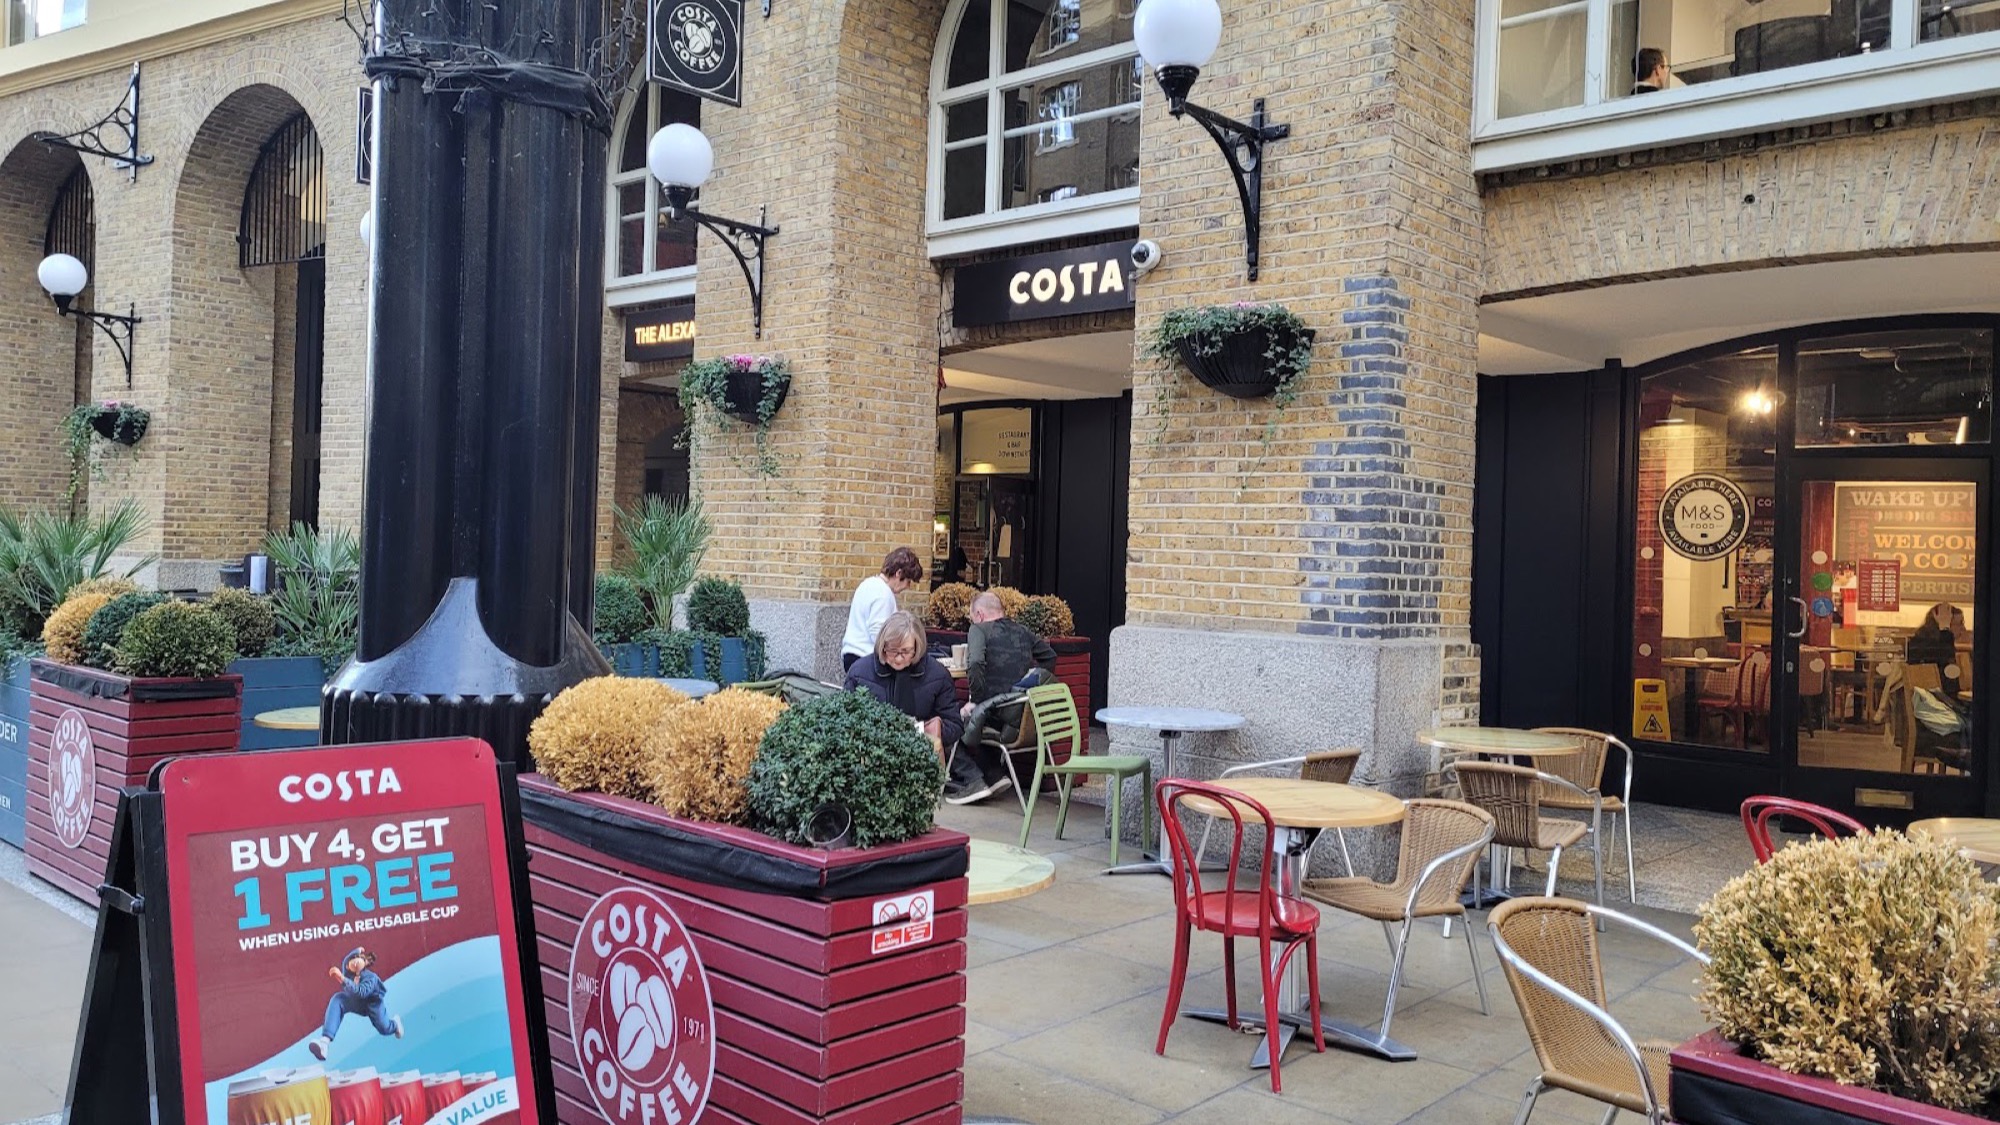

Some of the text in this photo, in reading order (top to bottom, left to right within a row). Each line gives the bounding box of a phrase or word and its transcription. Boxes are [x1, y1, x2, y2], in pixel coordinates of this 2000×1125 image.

[677, 6, 717, 32] COSTA
[674, 40, 721, 70] COFFEE
[1009, 258, 1125, 304] COSTA
[634, 325, 657, 345] THE
[1667, 480, 1740, 508] AVAILABLE HERE
[1851, 490, 1926, 506] WAKE
[1681, 504, 1726, 521] M&S
[1667, 530, 1739, 555] AVAILABLE HERE
[1900, 580, 1971, 596] PERTIS
[56, 717, 88, 759] COSTA
[278, 767, 402, 803] COSTA
[53, 789, 90, 839] COFFEE
[230, 816, 450, 873] BUY 4, GET
[233, 851, 459, 931] 1 FREE
[238, 905, 460, 951] WHEN USING A REUSABLE CUP
[591, 902, 689, 990] COSTA
[576, 971, 600, 998] SINCE
[683, 1016, 705, 1045] 1971
[583, 1027, 700, 1125] COFFEE
[446, 1089, 508, 1125] VALUE
